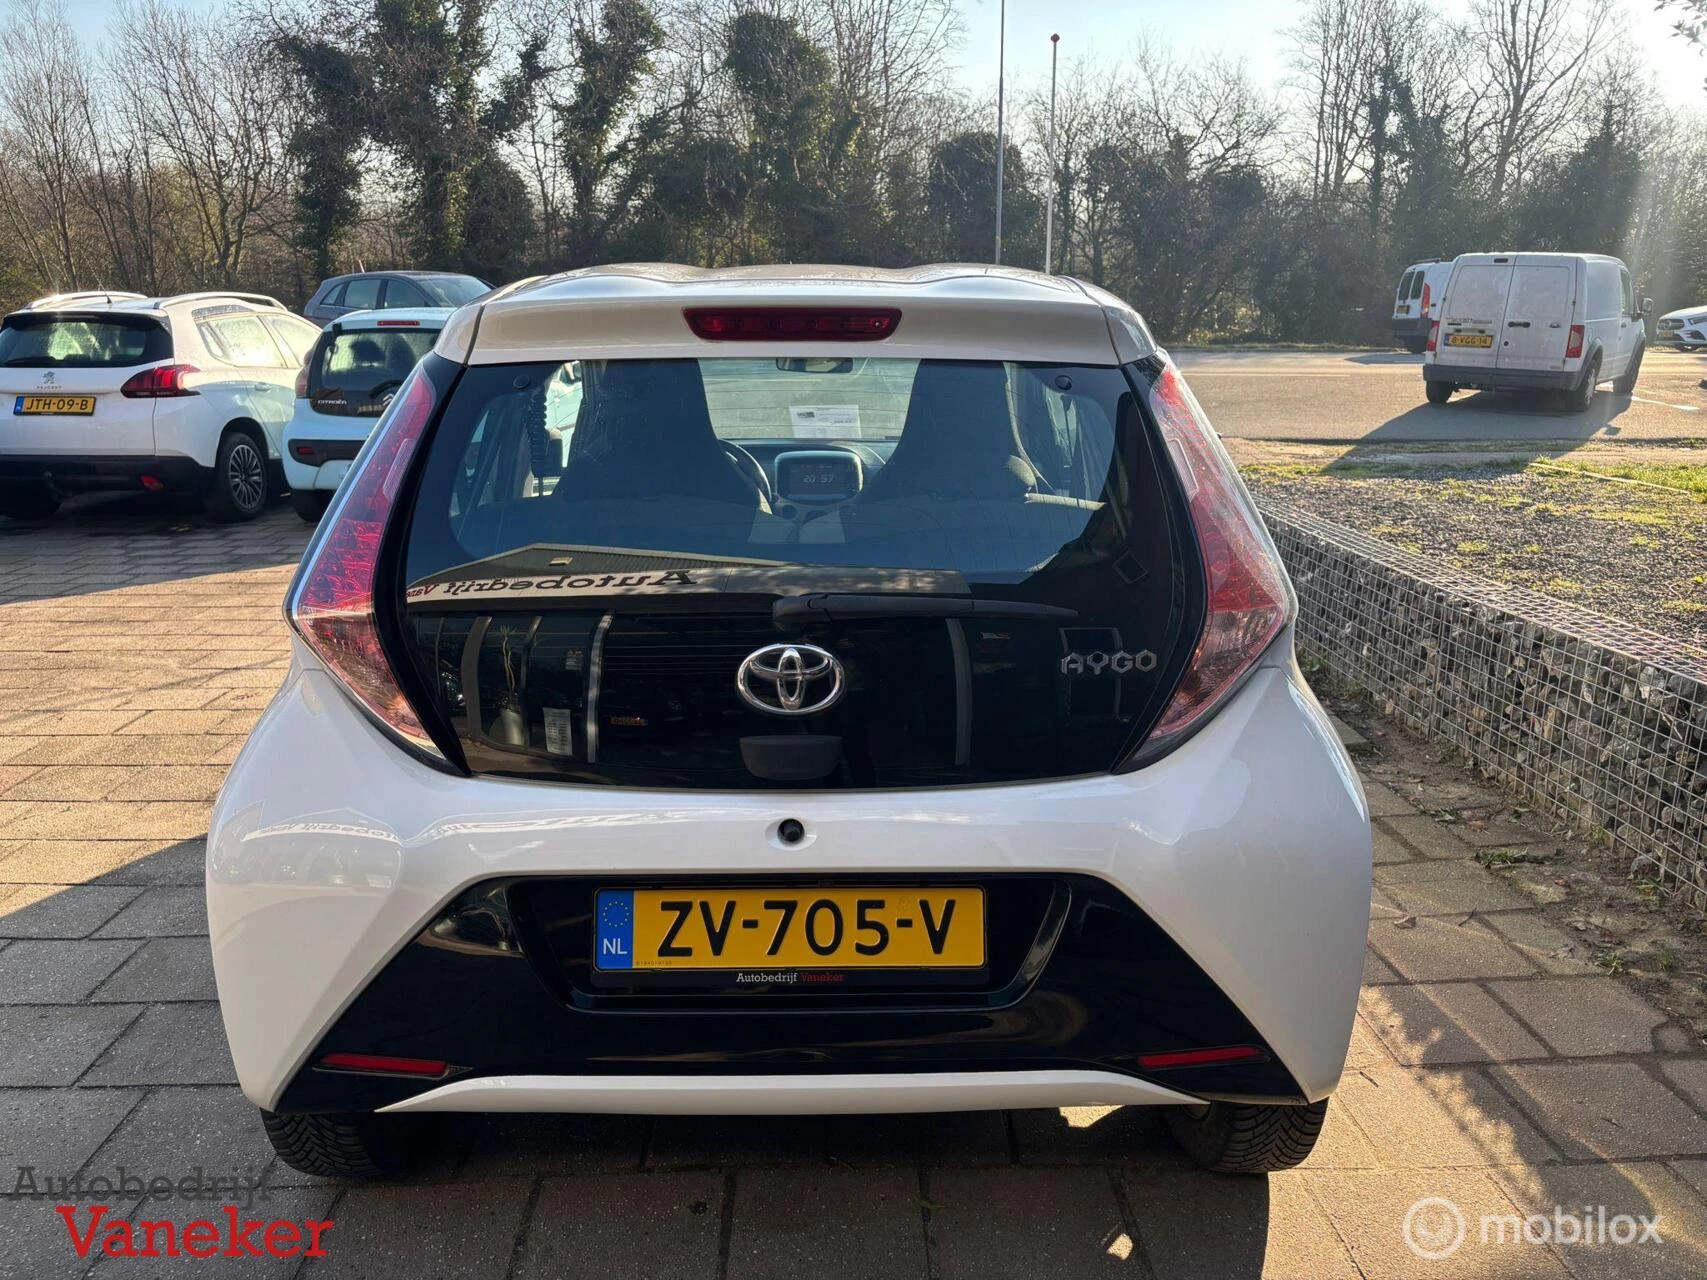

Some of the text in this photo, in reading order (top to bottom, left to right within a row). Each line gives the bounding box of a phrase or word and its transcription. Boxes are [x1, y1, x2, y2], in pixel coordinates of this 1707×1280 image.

[26, 398, 89, 411] JTH-09-B
[1060, 649, 1157, 675] AYGO
[657, 899, 956, 957] ZV-705-V
[603, 938, 628, 955] NL
[736, 972, 844, 984] Autobedrijf Vaneker
